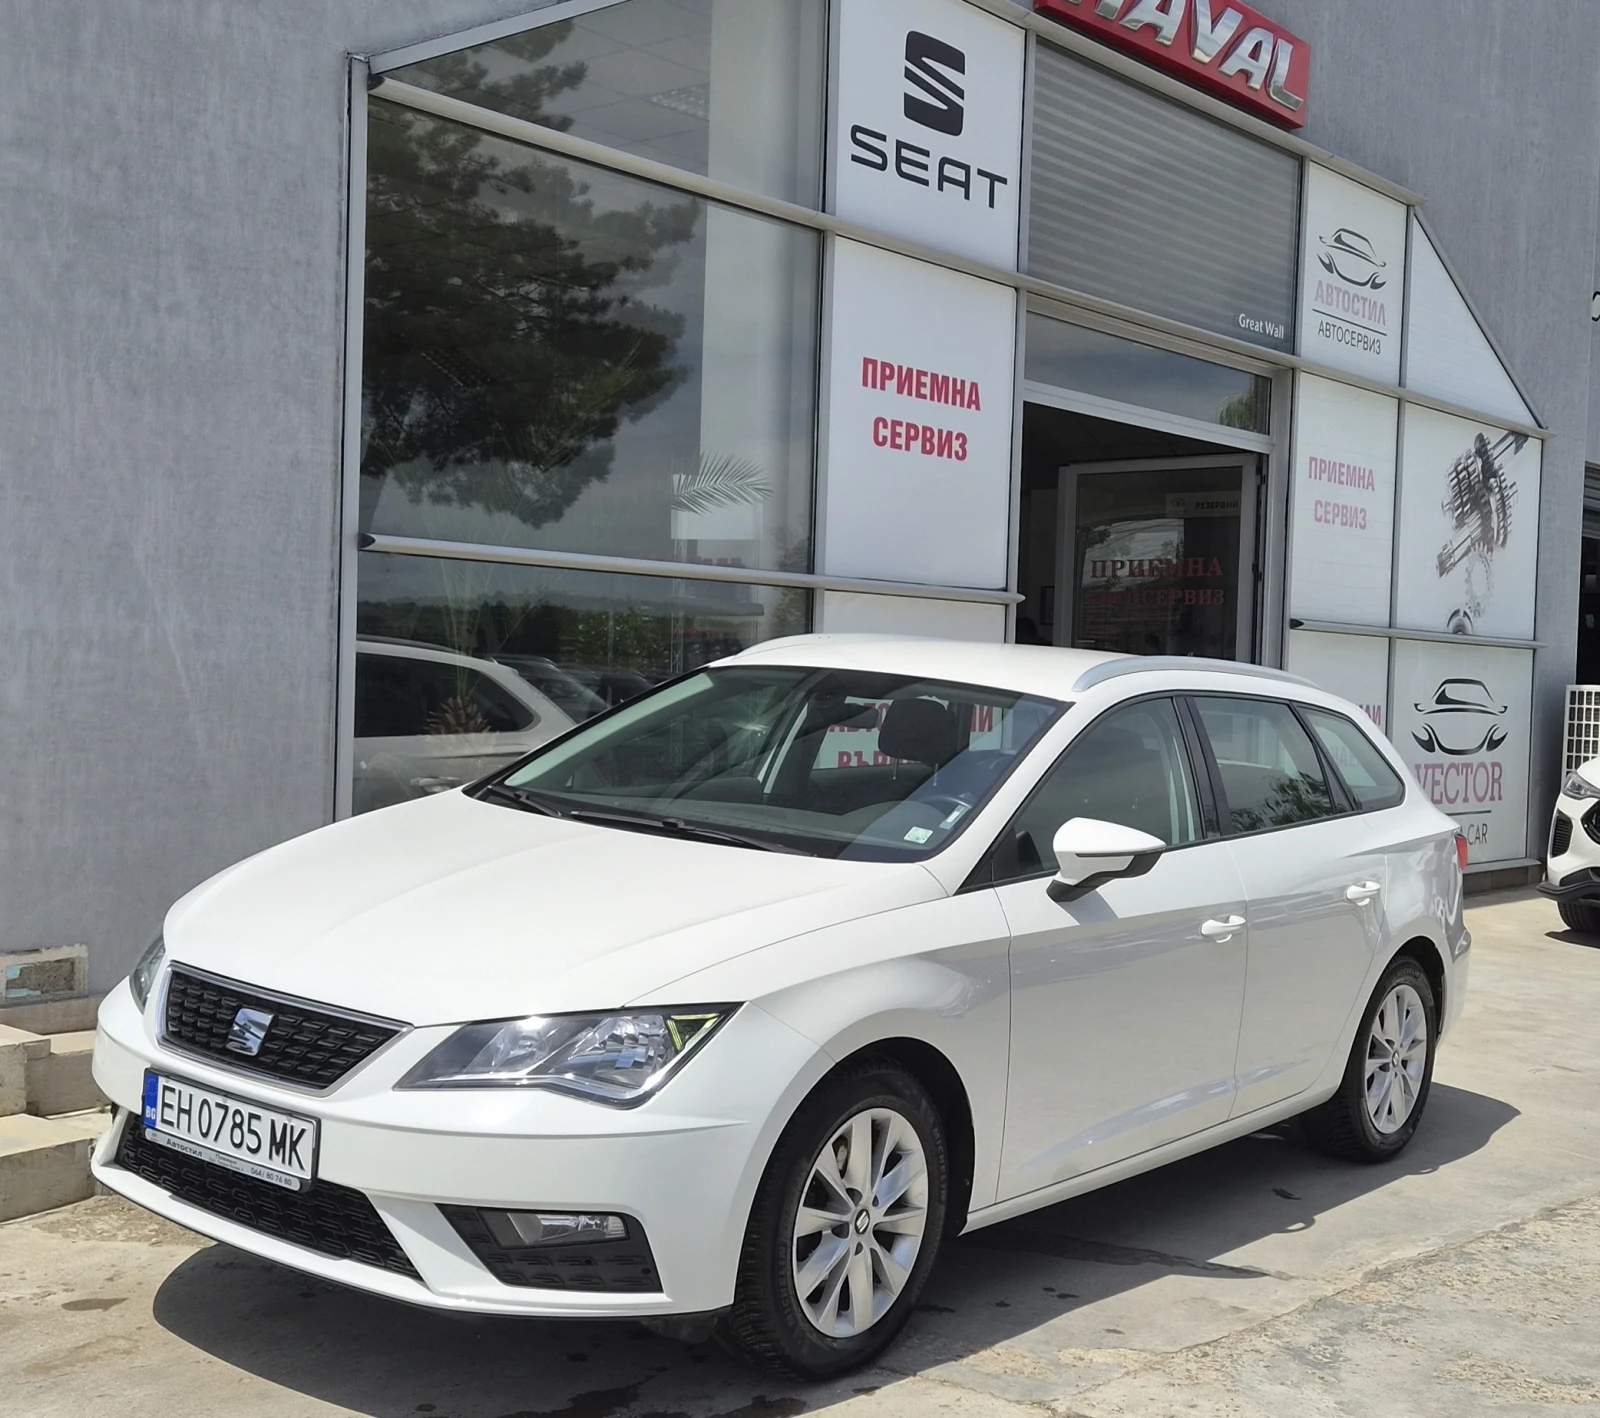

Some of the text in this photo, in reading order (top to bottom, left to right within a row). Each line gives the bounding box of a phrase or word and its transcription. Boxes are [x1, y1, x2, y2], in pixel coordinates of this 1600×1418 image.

[850, 124, 1008, 209] SEAT
[1315, 280, 1387, 326] АВТОСТИЛ
[1238, 313, 1285, 339] Great Wall
[1318, 320, 1382, 355] АВТОСЕРВИЗ
[862, 356, 981, 412] ПРИЕМНА
[873, 416, 968, 461] СЕРВИЗ
[1309, 456, 1375, 491] ПРИЕМНА
[1314, 499, 1367, 530] СЕРВИЗ
[1415, 761, 1503, 805] VECTOR
[1467, 823, 1488, 845] CAR
[145, 1105, 157, 1120] BG
[198, 1098, 262, 1155] 0785
